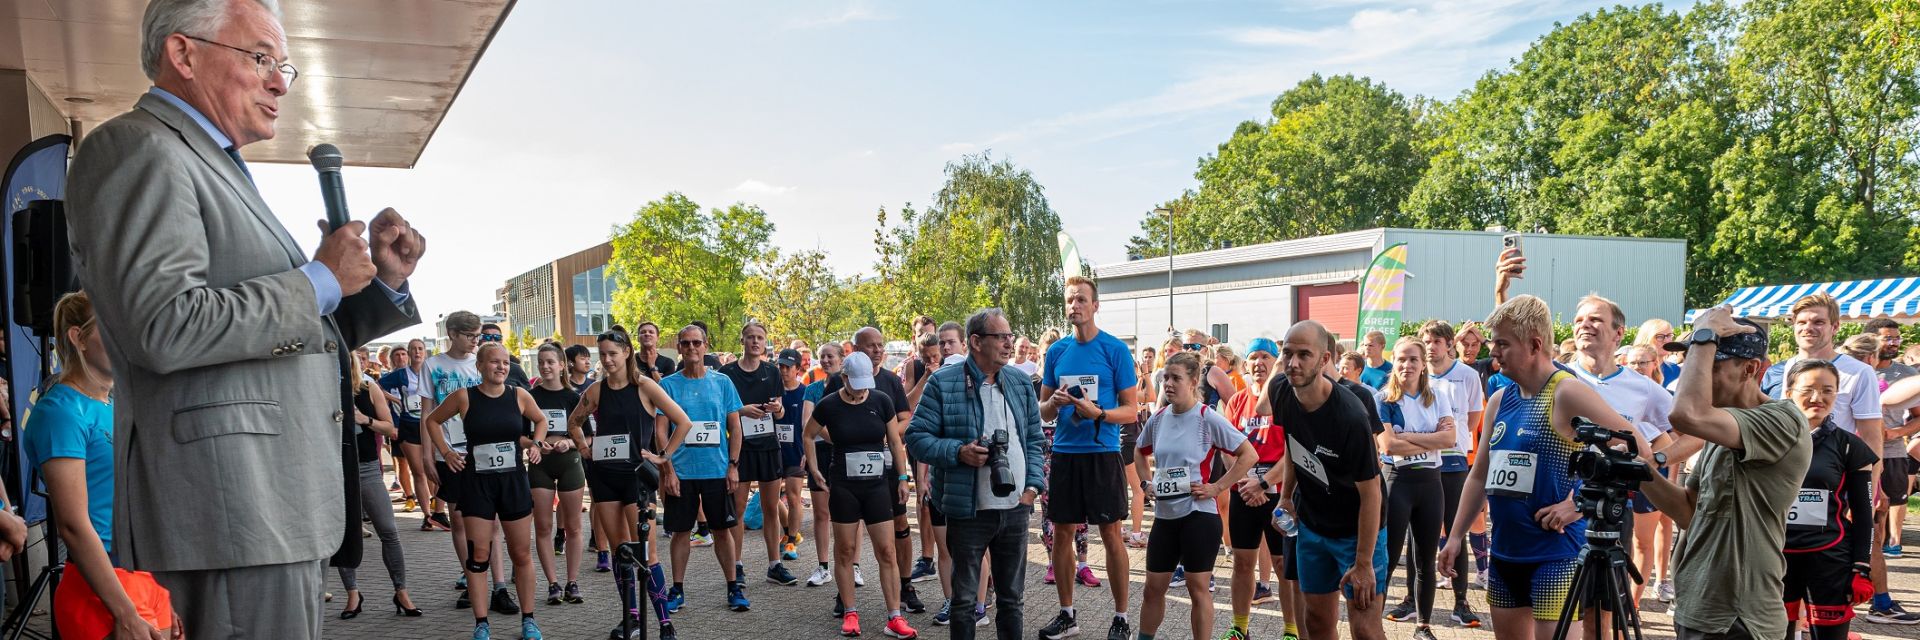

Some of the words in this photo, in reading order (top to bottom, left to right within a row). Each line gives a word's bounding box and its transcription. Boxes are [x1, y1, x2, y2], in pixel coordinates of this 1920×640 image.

[1364, 317, 1395, 326] GREAT
[754, 423, 765, 433] 13
[696, 432, 709, 442] 67
[603, 447, 617, 458] 18
[488, 455, 504, 467] 19
[1302, 455, 1317, 474] 38
[859, 463, 873, 474] 22
[1491, 469, 1517, 487] 109
[1156, 481, 1180, 494] 481
